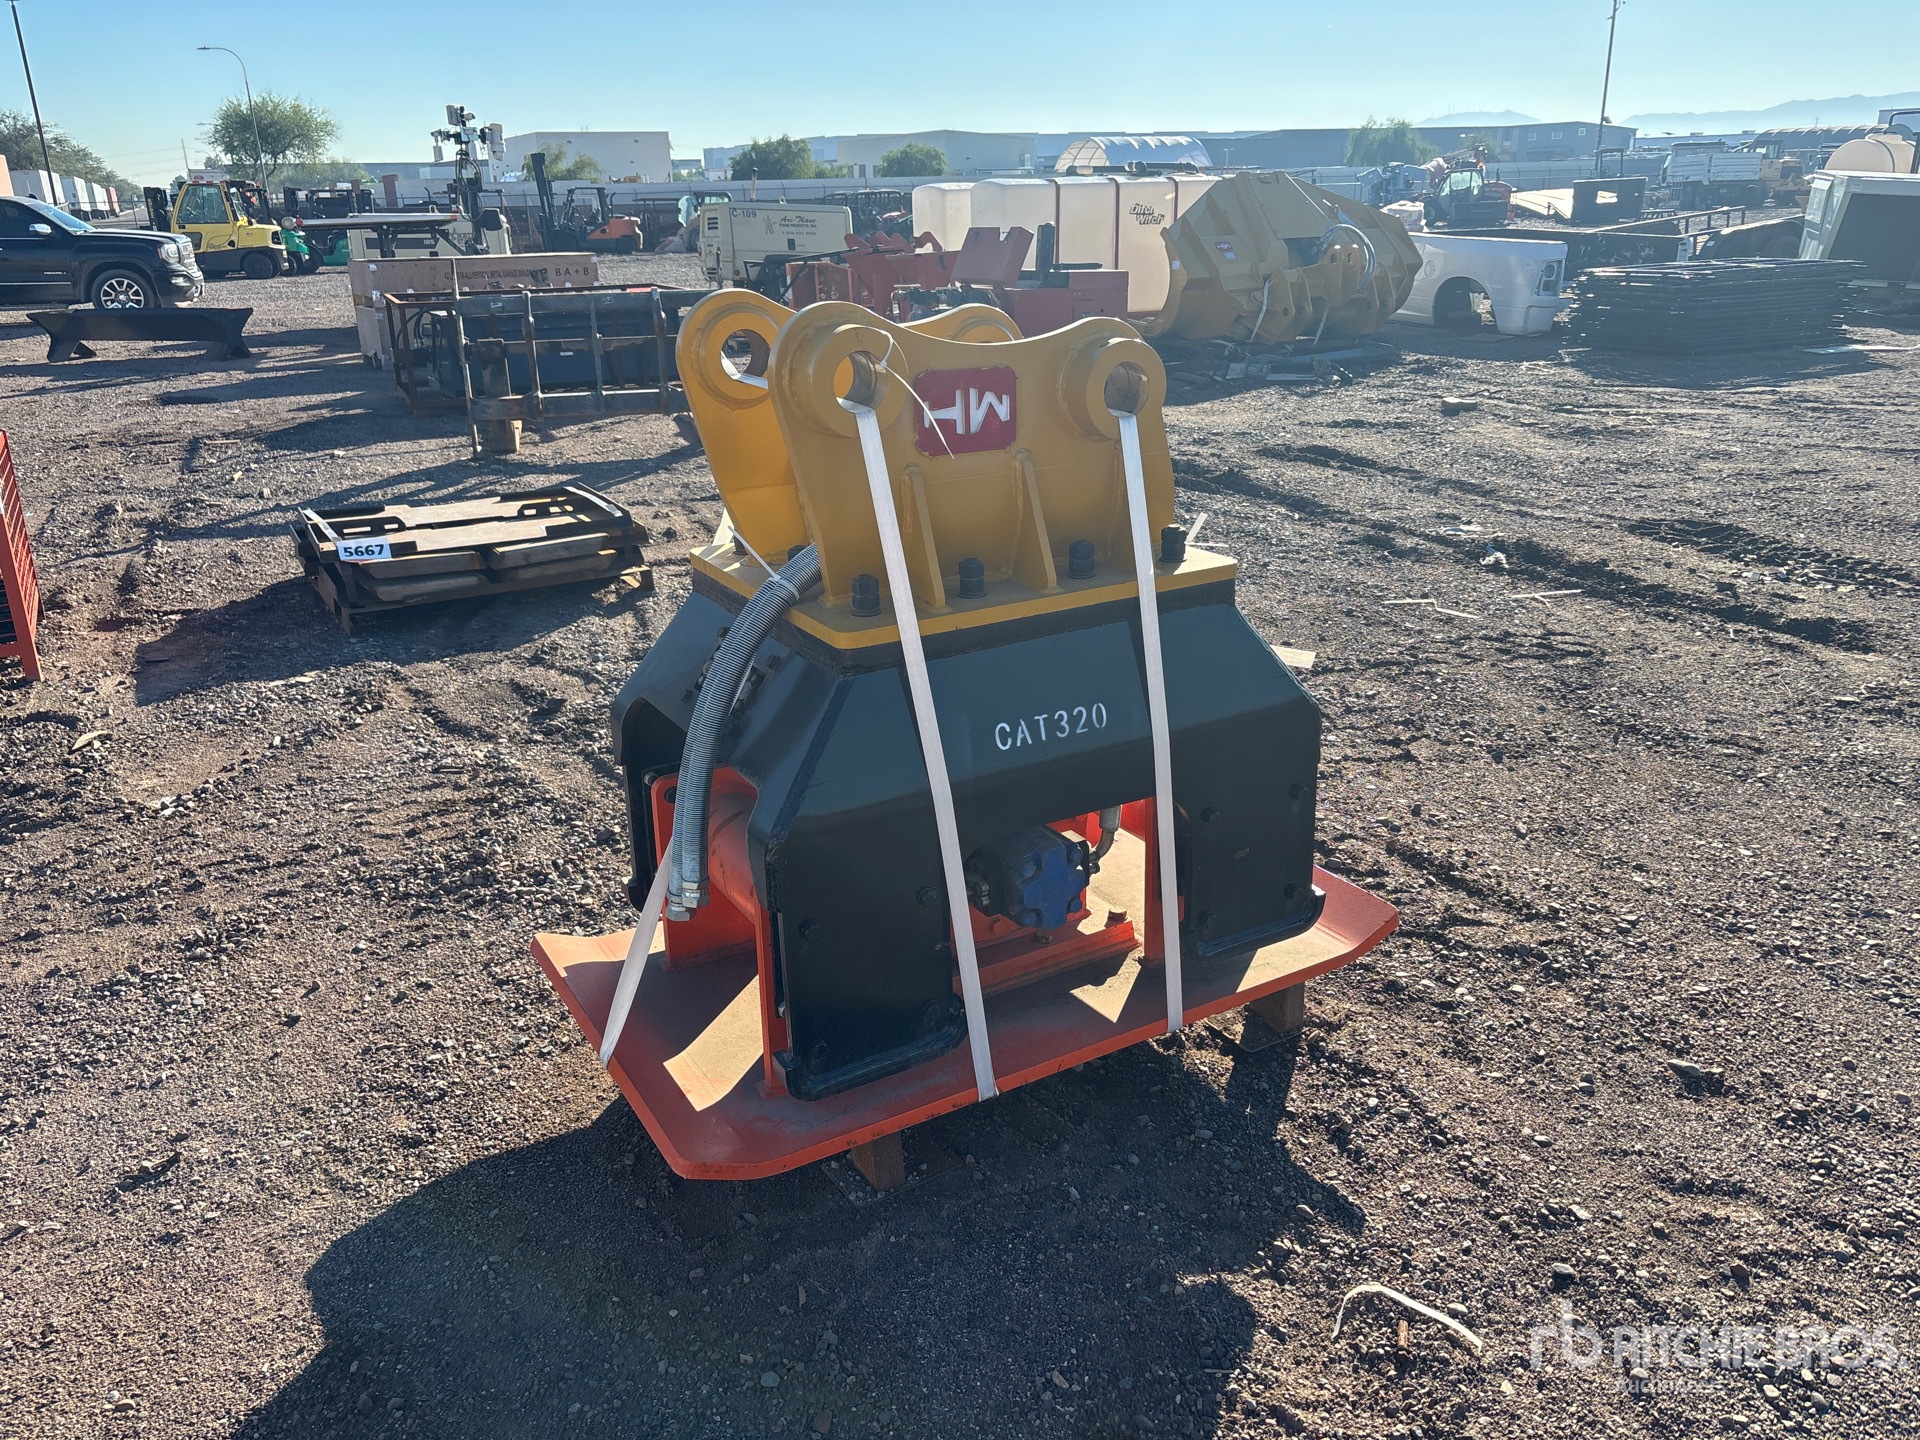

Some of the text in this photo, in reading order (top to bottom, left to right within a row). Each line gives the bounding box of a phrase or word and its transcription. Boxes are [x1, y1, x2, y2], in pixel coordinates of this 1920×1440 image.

[731, 209, 757, 218] C-109
[1129, 202, 1155, 215] Ditch
[1136, 213, 1165, 225] Witch
[343, 543, 385, 557] 5667
[994, 701, 1108, 751] CAT320
